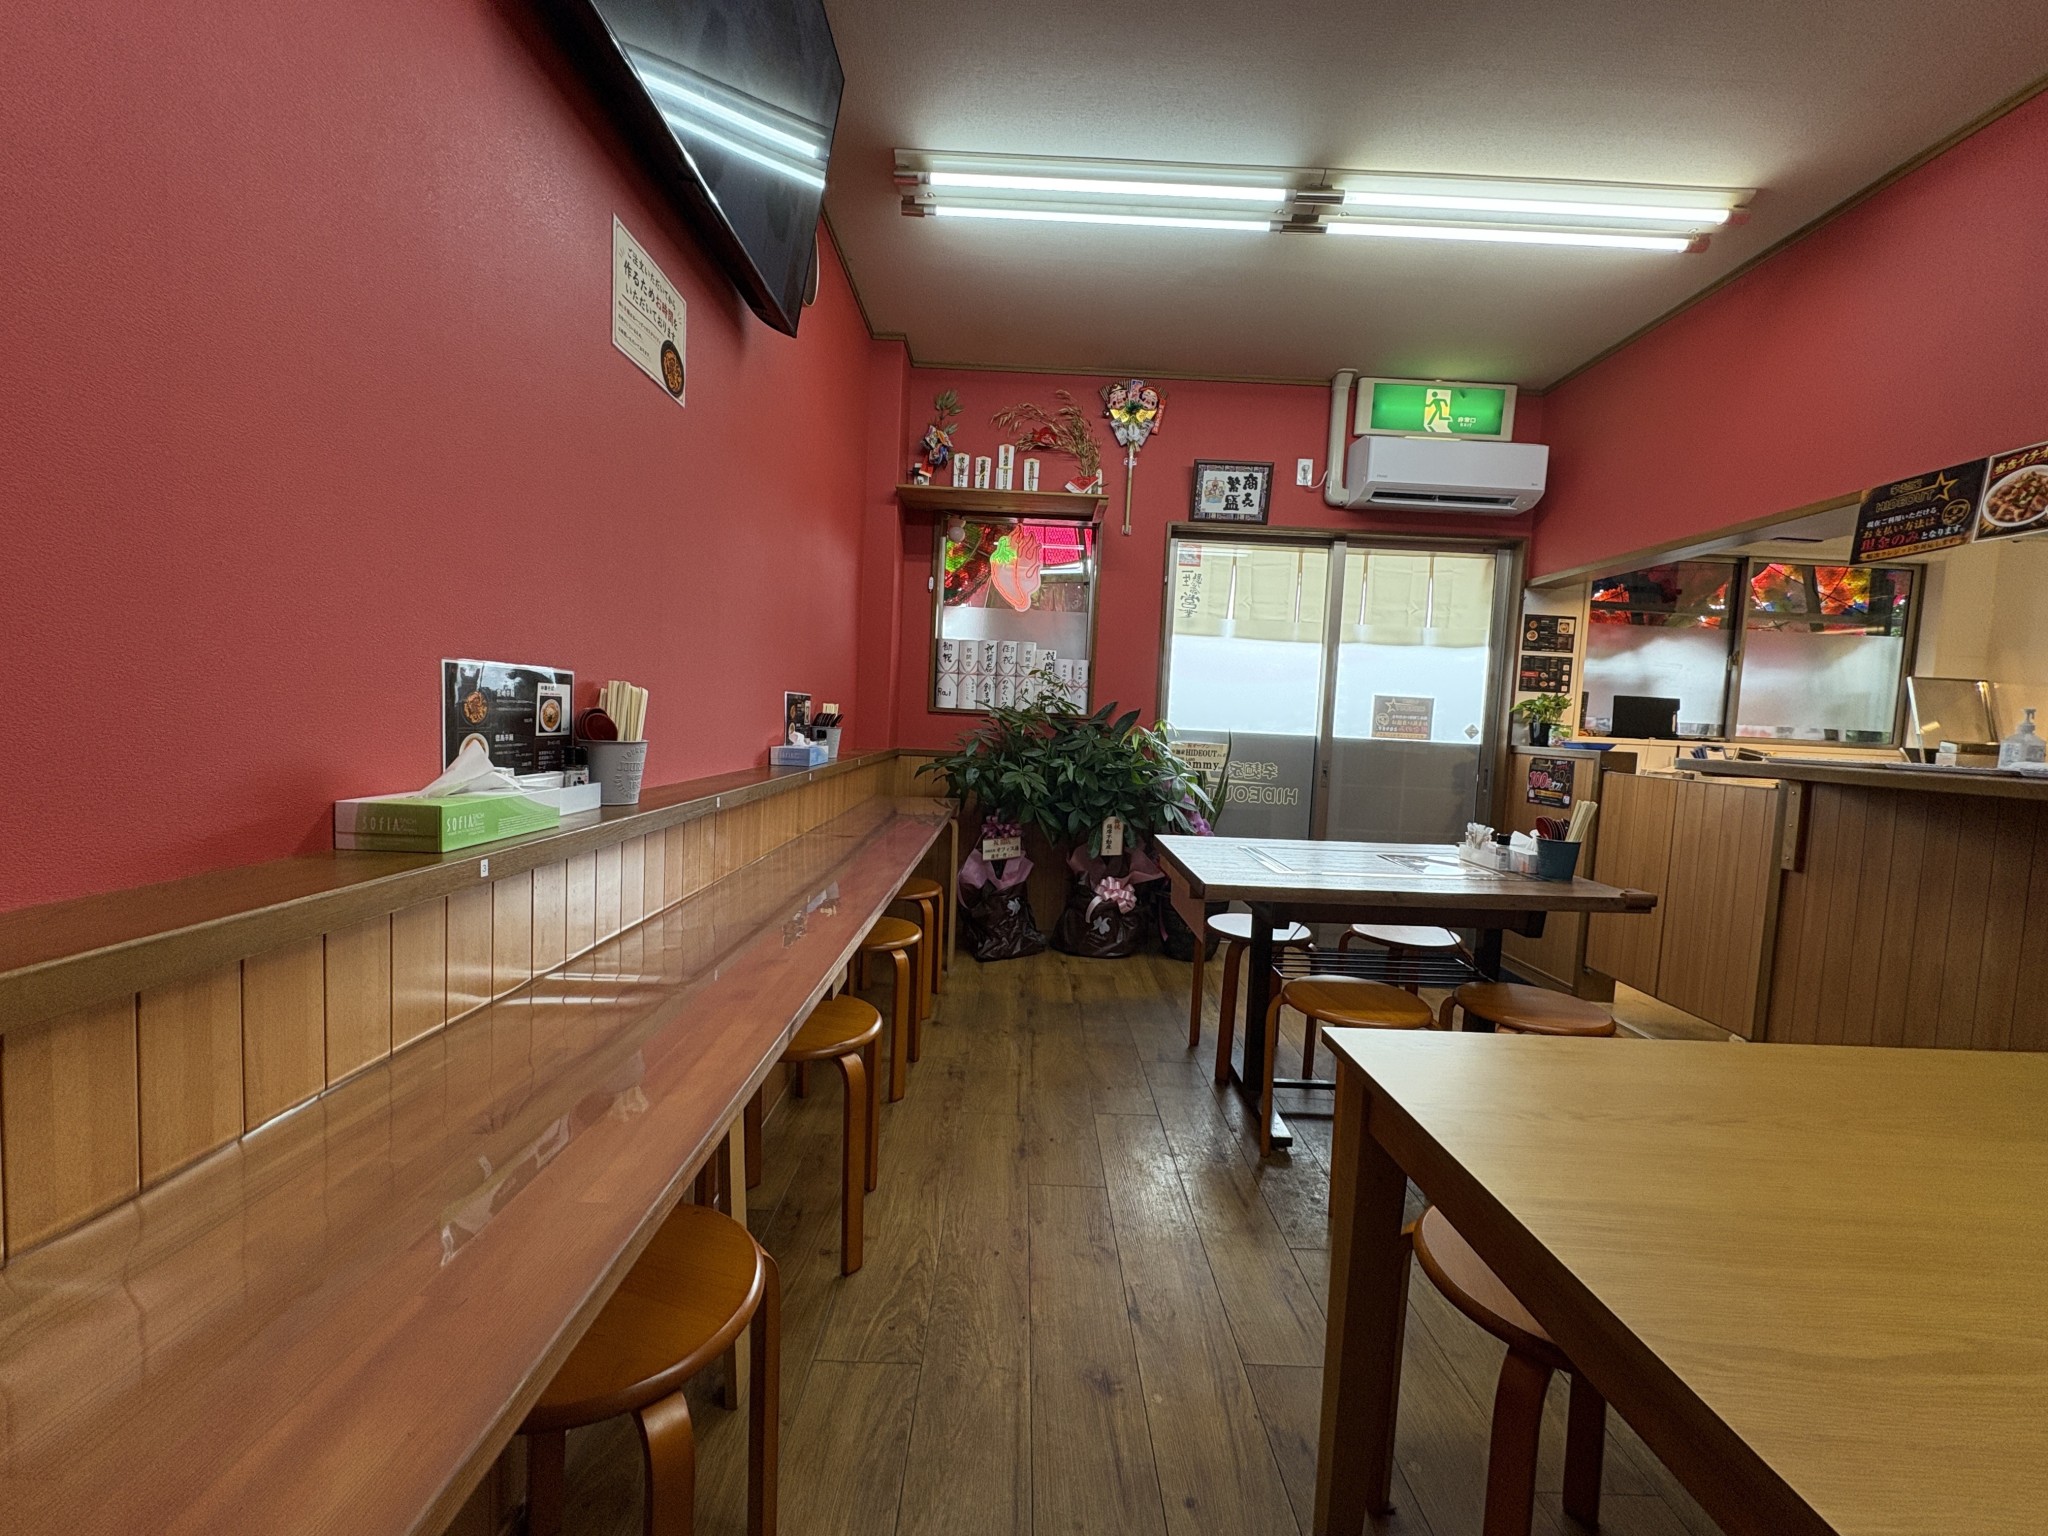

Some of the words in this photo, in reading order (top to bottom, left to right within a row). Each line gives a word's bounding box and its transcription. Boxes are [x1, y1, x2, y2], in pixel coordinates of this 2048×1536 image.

[626, 247, 677, 311] ご注文いただいてから
[623, 261, 679, 332] 作るためお時間を
[625, 281, 676, 344] いただいております
[1457, 416, 1477, 424] 非常口
[1223, 475, 1241, 511] 繁盛
[1242, 473, 1258, 508] 商売
[1875, 489, 1935, 513] HIDEOUT
[1861, 531, 1919, 550] 現金のみ
[1002, 644, 1015, 665] 御祝
[1185, 749, 1217, 758] HIDEOUT
[481, 864, 487, 873] 3
